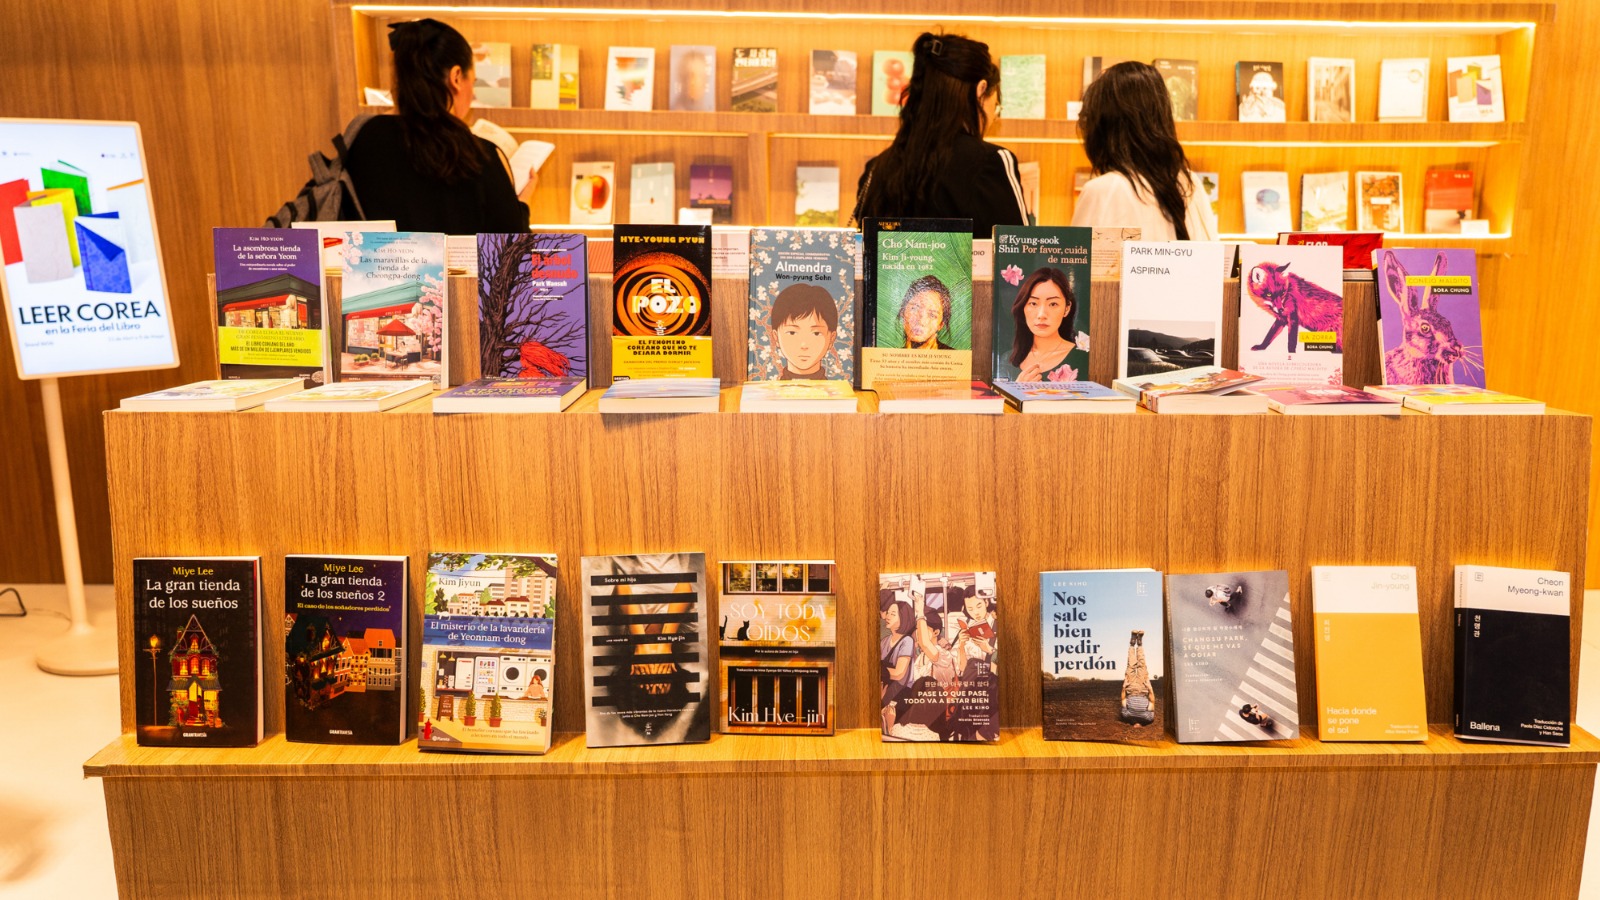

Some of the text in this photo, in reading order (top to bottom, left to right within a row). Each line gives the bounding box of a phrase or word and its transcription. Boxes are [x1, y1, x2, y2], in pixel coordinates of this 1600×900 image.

[678, 236, 705, 244] PYUN
[882, 239, 947, 251] Cho Nam-joo
[1009, 234, 1060, 246] Kyung-sook
[233, 244, 242, 252] La
[243, 244, 279, 252] asombrosa
[998, 244, 1088, 255] Shin Por favor, cuida
[1131, 247, 1193, 257] PARK MIN-GYU
[238, 252, 247, 260] de
[248, 252, 254, 260] la
[360, 256, 372, 264] Las
[373, 256, 409, 264] maravillas
[411, 256, 419, 264] de
[532, 253, 572, 266] El árbol
[882, 253, 899, 261] Kim
[1047, 255, 1088, 264] de mamá
[378, 264, 399, 272] tienda
[775, 260, 833, 273] Almendra
[882, 262, 905, 270] nacida
[1130, 266, 1171, 275] ASPIRINA
[366, 271, 421, 281] Cheongpa-dong
[531, 268, 579, 279] desnudo
[775, 273, 833, 282] Won-pyung Sohn
[532, 280, 546, 288] Park
[651, 278, 677, 294] EL
[632, 295, 703, 314] POZO
[18, 300, 162, 325] LEER COREA
[45, 321, 141, 336] en la Feria del Libro
[172, 566, 215, 578] Miye Lee
[323, 563, 365, 575] Miye Lee
[305, 573, 383, 587] La gran tienda
[438, 577, 482, 588] Kim Jiyun
[1390, 572, 1410, 581] Choi
[1537, 577, 1564, 587] Cheon
[146, 579, 241, 594] La gran tienda
[1370, 582, 1411, 592] Jin-young
[1507, 585, 1565, 598] Myeong-kwan
[300, 588, 386, 602] de los sueños 2
[1053, 591, 1087, 606] Nos
[149, 597, 239, 609] de los sueños
[730, 602, 827, 621] SOY TODA
[1053, 607, 1088, 622] sale
[430, 621, 547, 635] El misterio de la lavandería
[746, 621, 811, 642] OÍDOS
[1054, 623, 1093, 639] bien
[448, 632, 528, 646] de Yeonnam-dong
[1054, 639, 1102, 659] pedir
[1054, 656, 1117, 674] perdón
[950, 690, 967, 698] QUE
[968, 690, 990, 698] PASE,
[728, 706, 825, 727] Kim Hye-jin
[1326, 706, 1378, 715] Hacia donde
[1327, 717, 1361, 726] se pone
[1469, 720, 1501, 732] Ballena
[1327, 725, 1350, 734] el sol
